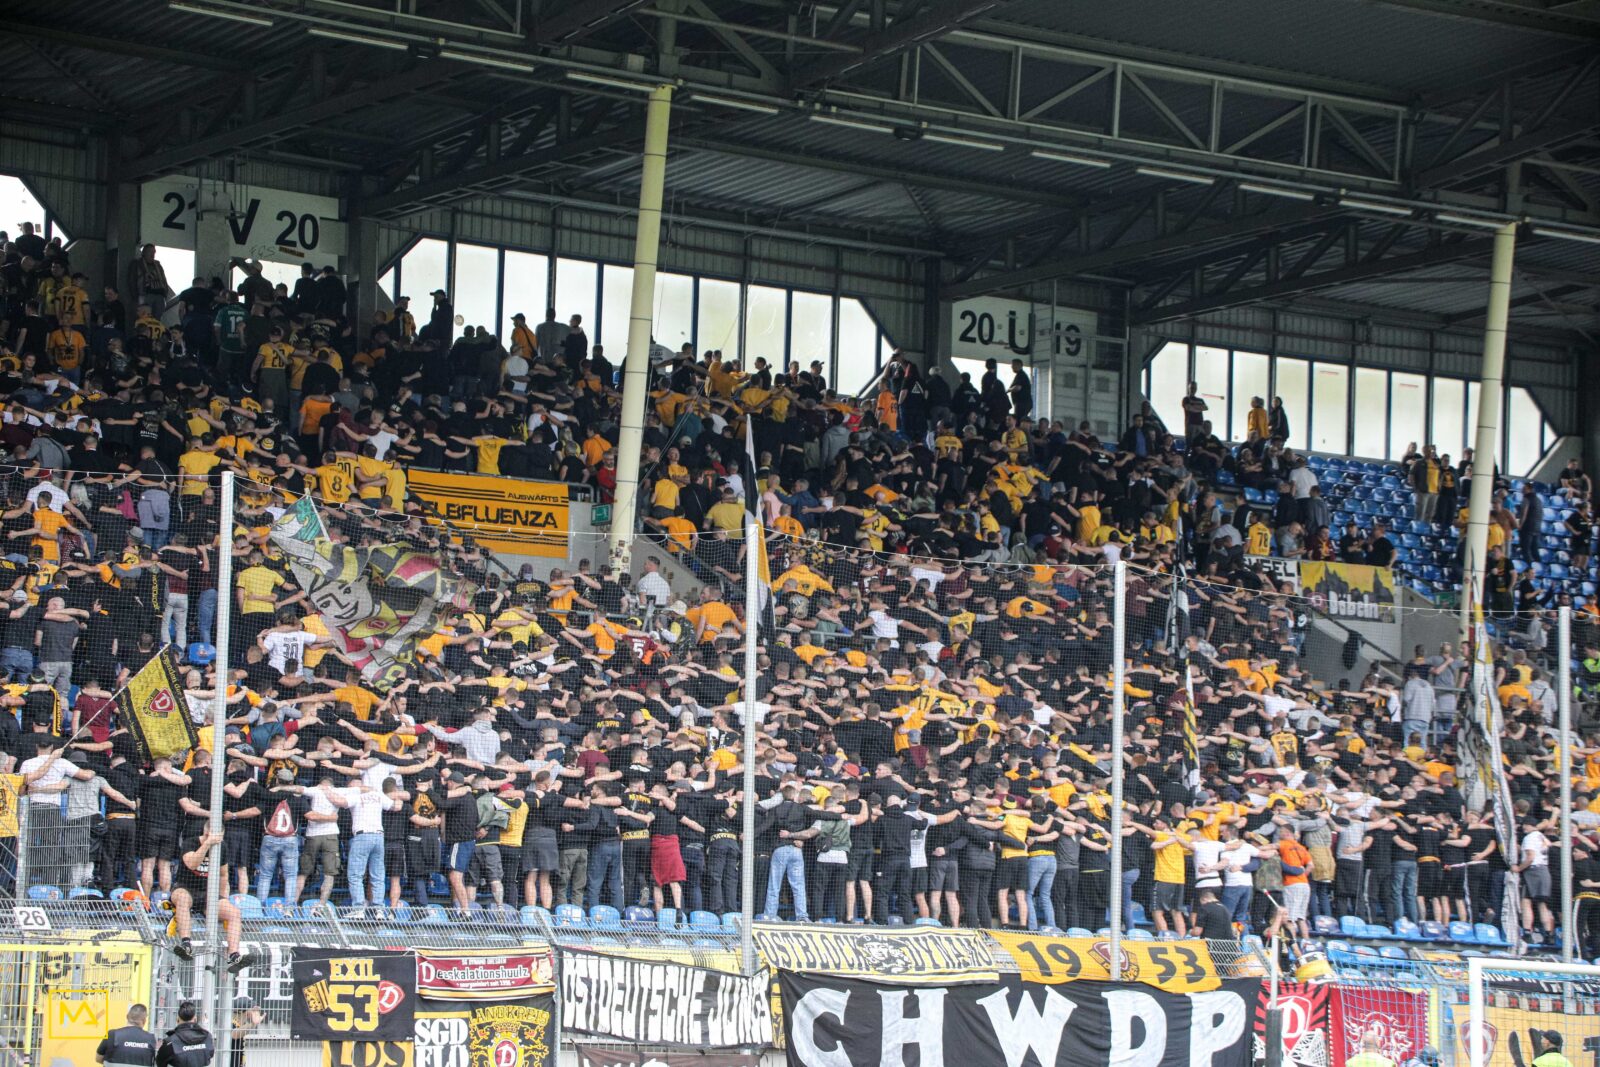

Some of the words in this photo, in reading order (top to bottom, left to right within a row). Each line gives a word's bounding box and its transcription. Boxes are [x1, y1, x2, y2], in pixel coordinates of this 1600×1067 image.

[275, 210, 319, 250] 20
[958, 310, 995, 345] 20
[1055, 322, 1082, 357] 19
[332, 475, 342, 492] 8
[18, 909, 46, 927] 26
[756, 931, 871, 972] OSTBLOCK
[1018, 940, 1082, 978] 19
[1147, 945, 1206, 984] 53
[328, 958, 380, 982] EXIL
[327, 984, 379, 1032] 53
[414, 1018, 469, 1046] SGD
[790, 984, 1247, 1067] CHWDP
[124, 1041, 149, 1049] ORDNER
[182, 1043, 207, 1051] ORDNER
